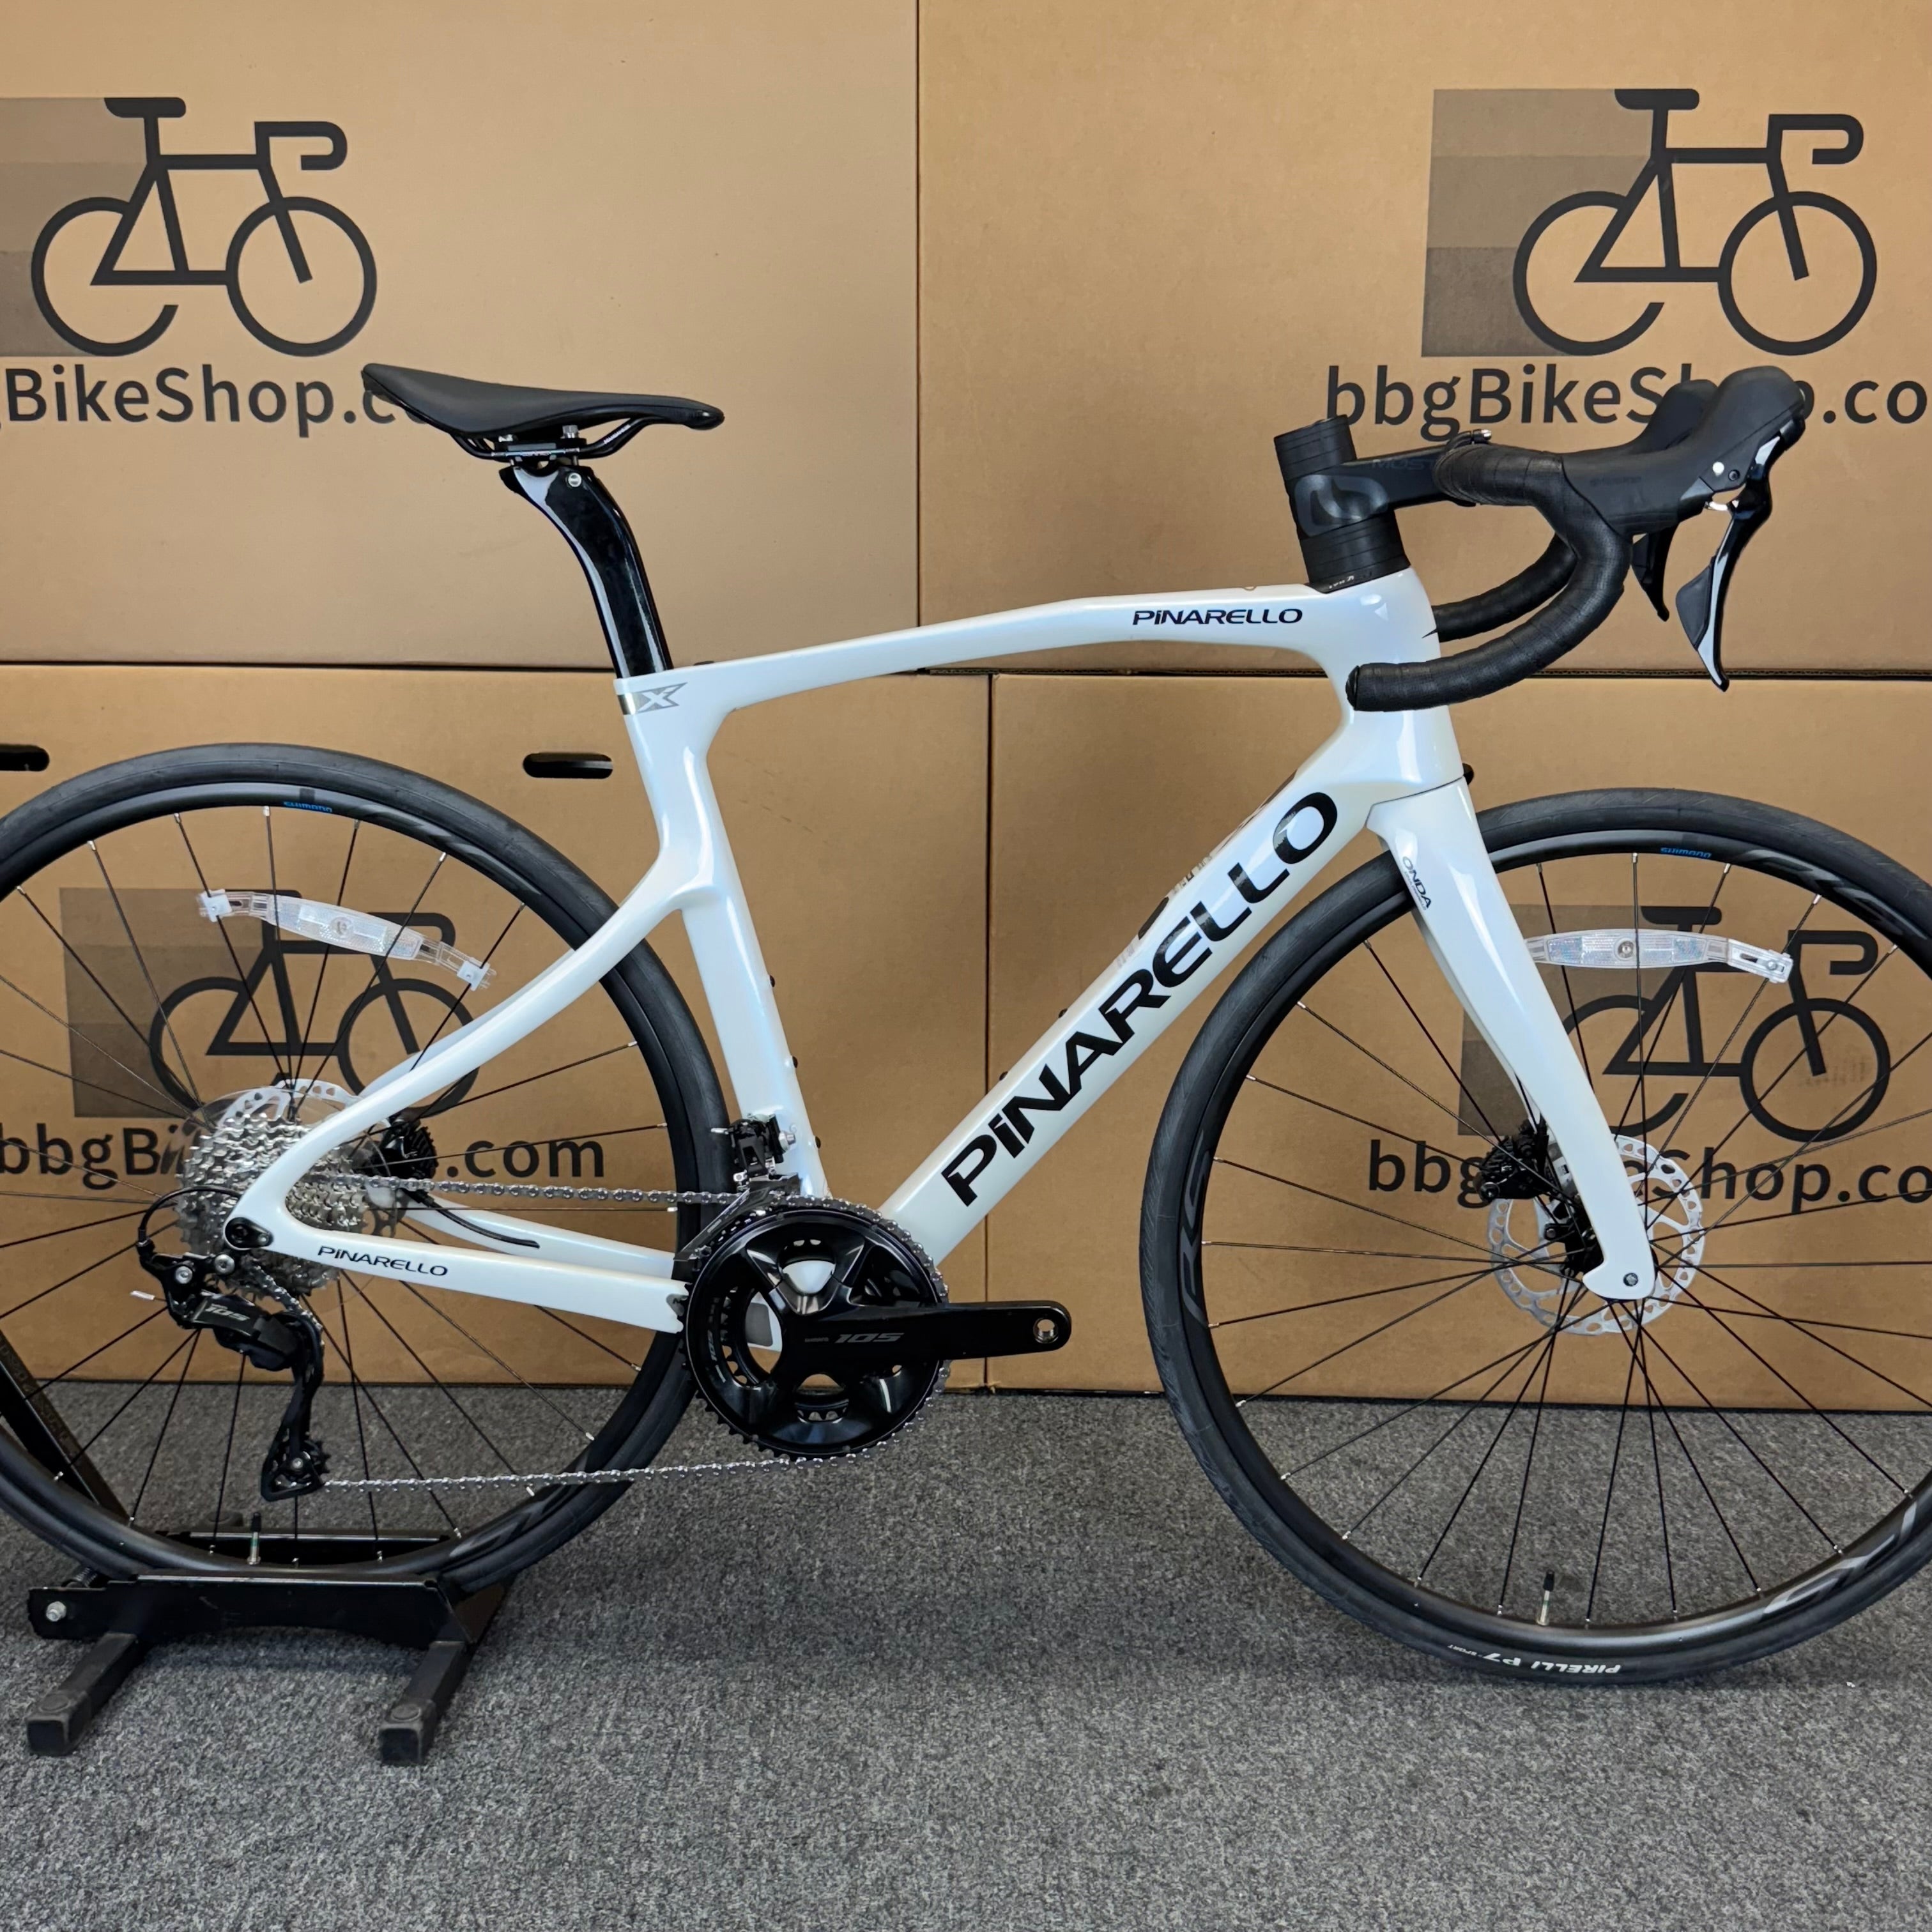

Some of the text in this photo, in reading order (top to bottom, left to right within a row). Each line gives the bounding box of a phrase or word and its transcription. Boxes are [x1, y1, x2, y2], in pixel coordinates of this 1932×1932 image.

[5, 364, 427, 438] BikeShop.c
[1327, 363, 1928, 442] bbgBikeS.co
[1402, 856, 1432, 908] ONDA
[205, 1307, 250, 1321] 105
[834, 1332, 905, 1344] 105
[1531, 1661, 1621, 1673] PIRELLI
